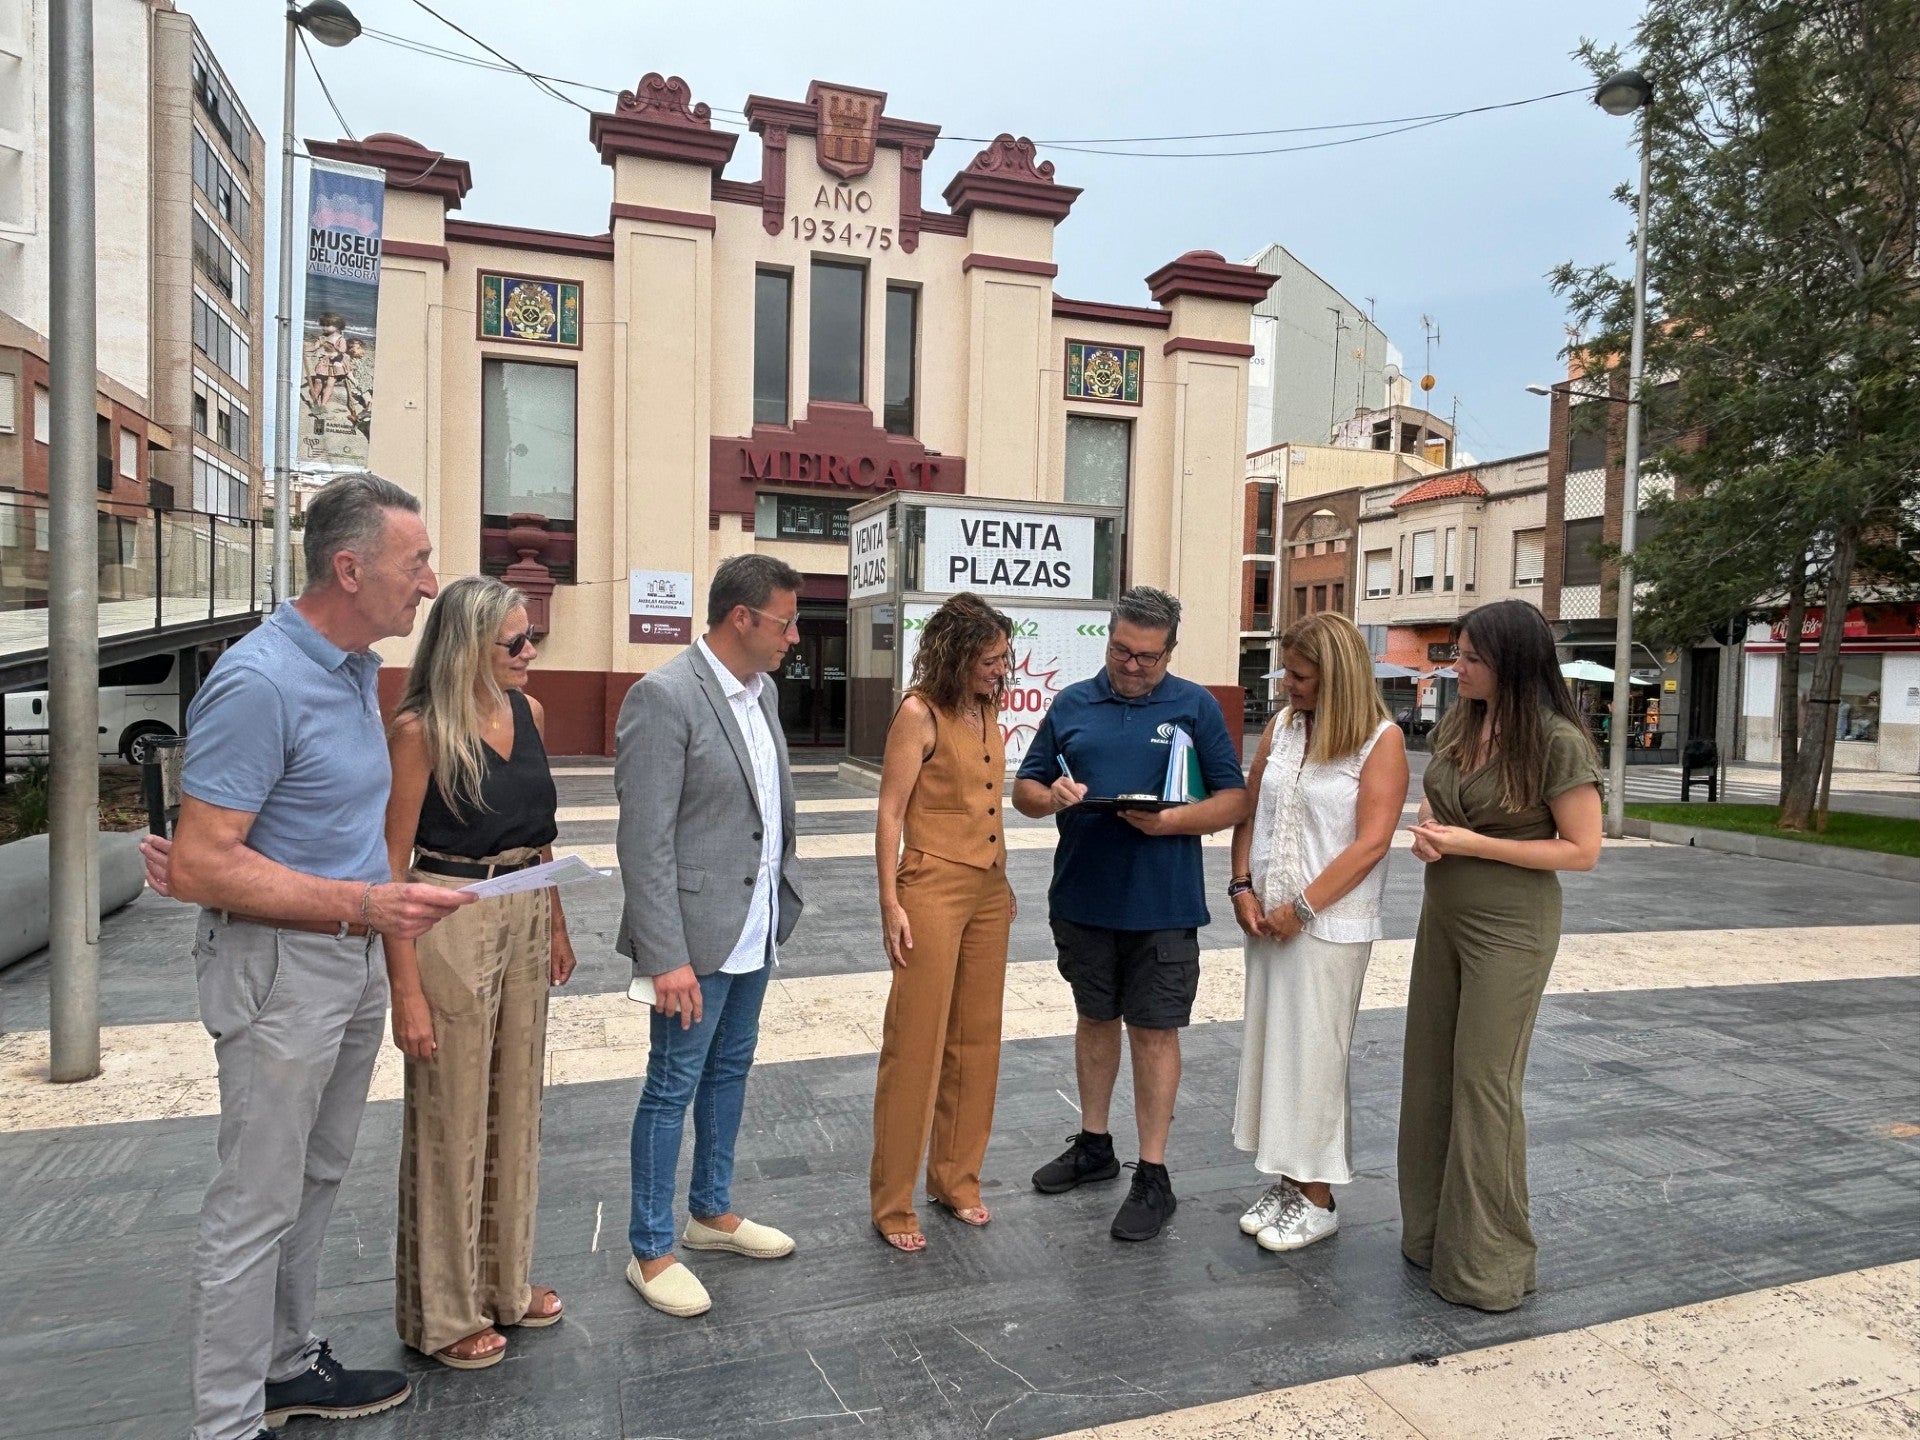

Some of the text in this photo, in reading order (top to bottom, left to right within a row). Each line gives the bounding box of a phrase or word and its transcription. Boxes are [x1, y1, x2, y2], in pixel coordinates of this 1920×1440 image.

[814, 181, 873, 213] AÑO
[309, 247, 378, 271] DEL JOGUET
[310, 228, 379, 257] MUSEU
[308, 262, 377, 281] ALMASSORA
[739, 447, 940, 491] MERCAT
[855, 521, 884, 555] VENTA
[961, 518, 1062, 552] VENTA
[852, 556, 886, 590] PLAZAS
[949, 555, 1071, 588] PLAZAS
